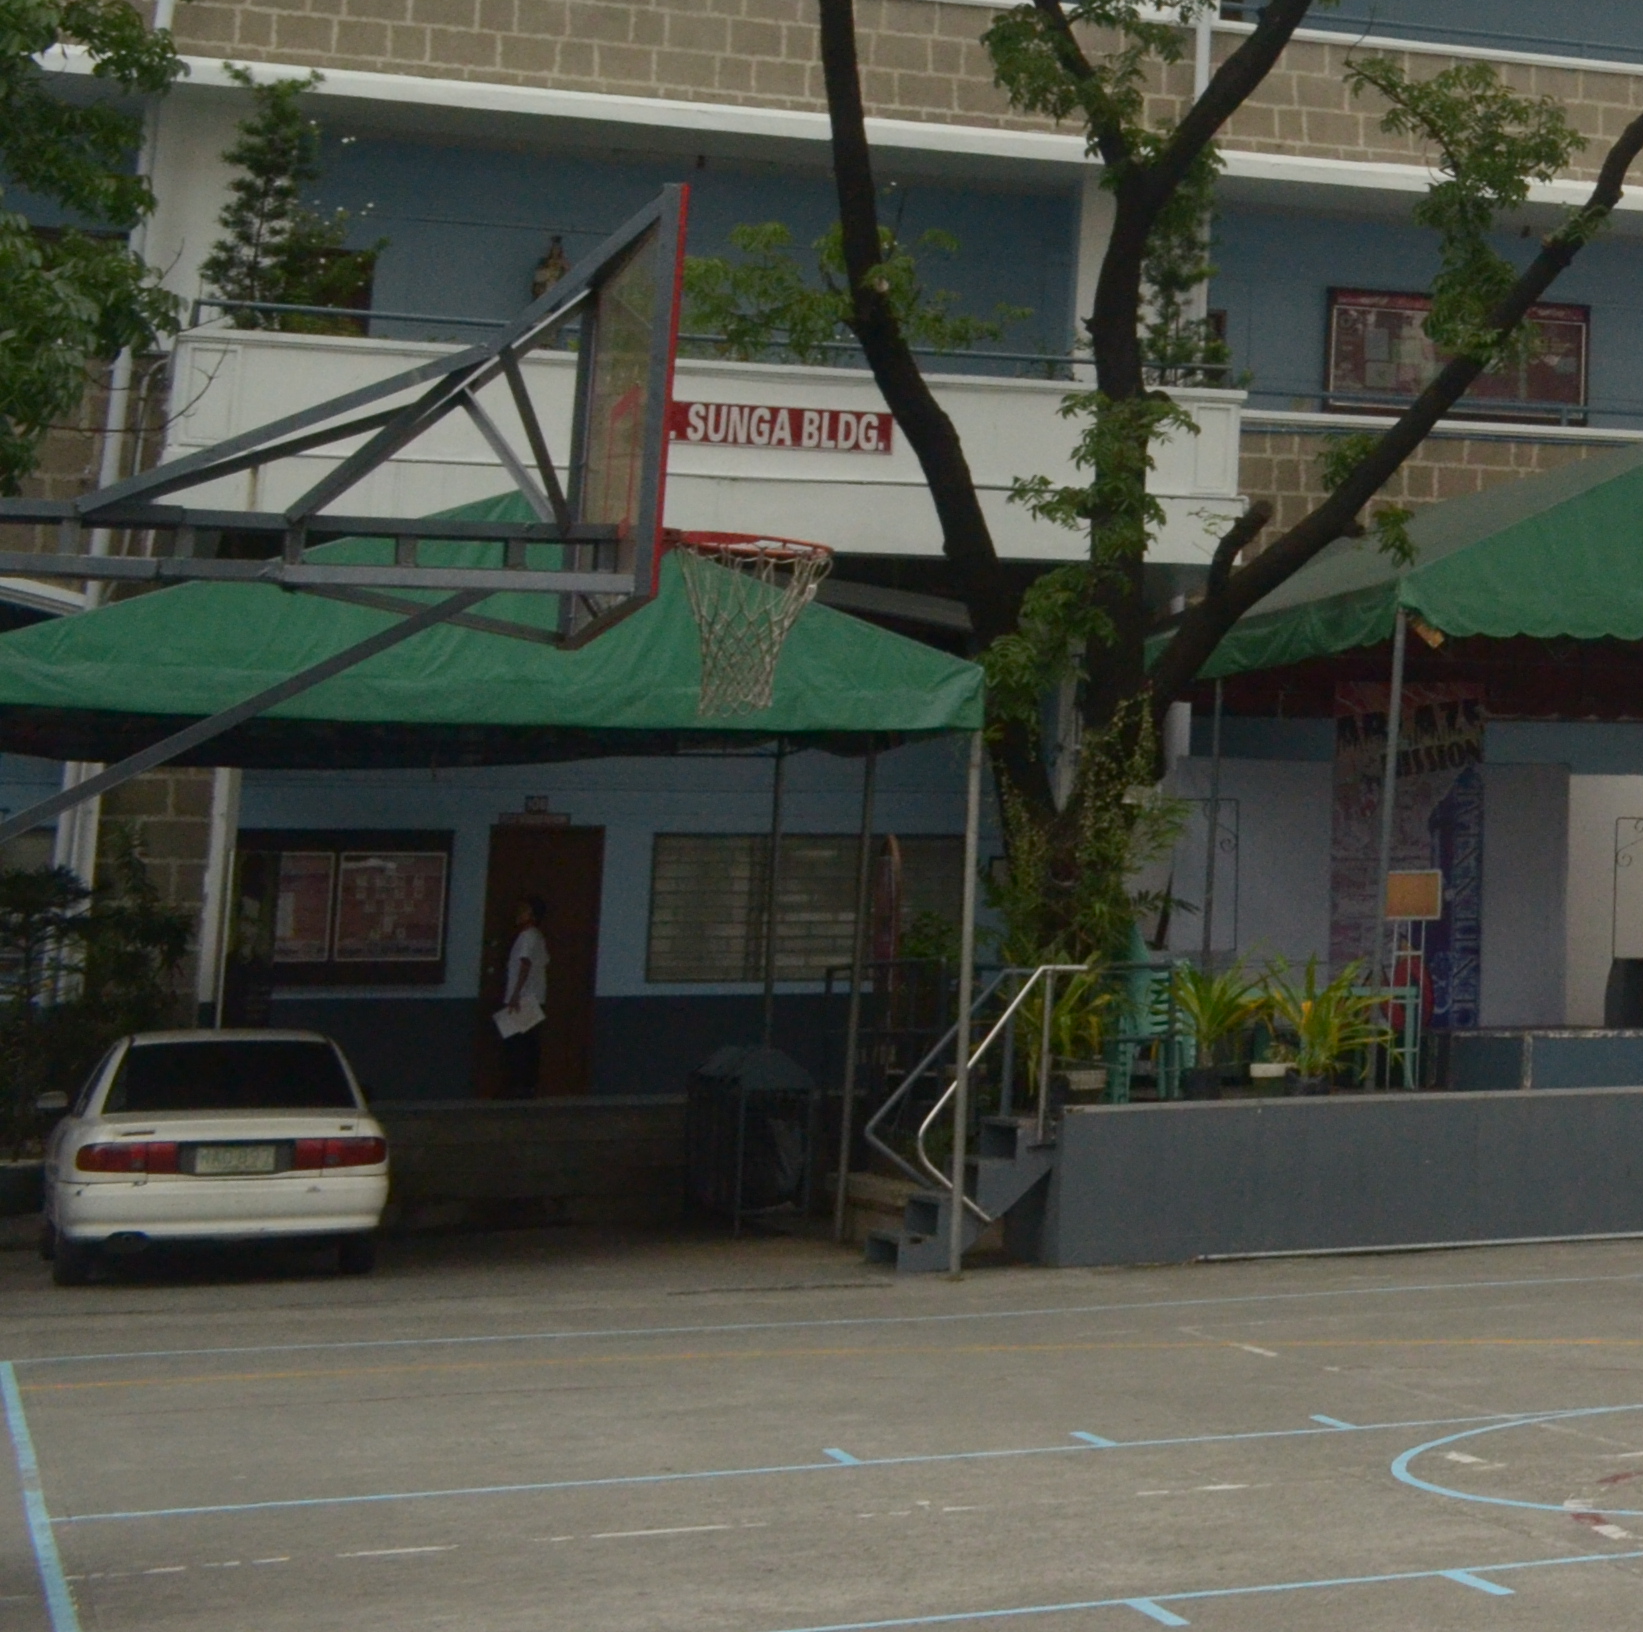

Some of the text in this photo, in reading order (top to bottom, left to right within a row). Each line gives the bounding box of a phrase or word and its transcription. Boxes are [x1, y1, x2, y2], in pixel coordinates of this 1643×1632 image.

[686, 403, 884, 451] SUNGA BLDG.
[1335, 697, 1483, 749] ABAZE
